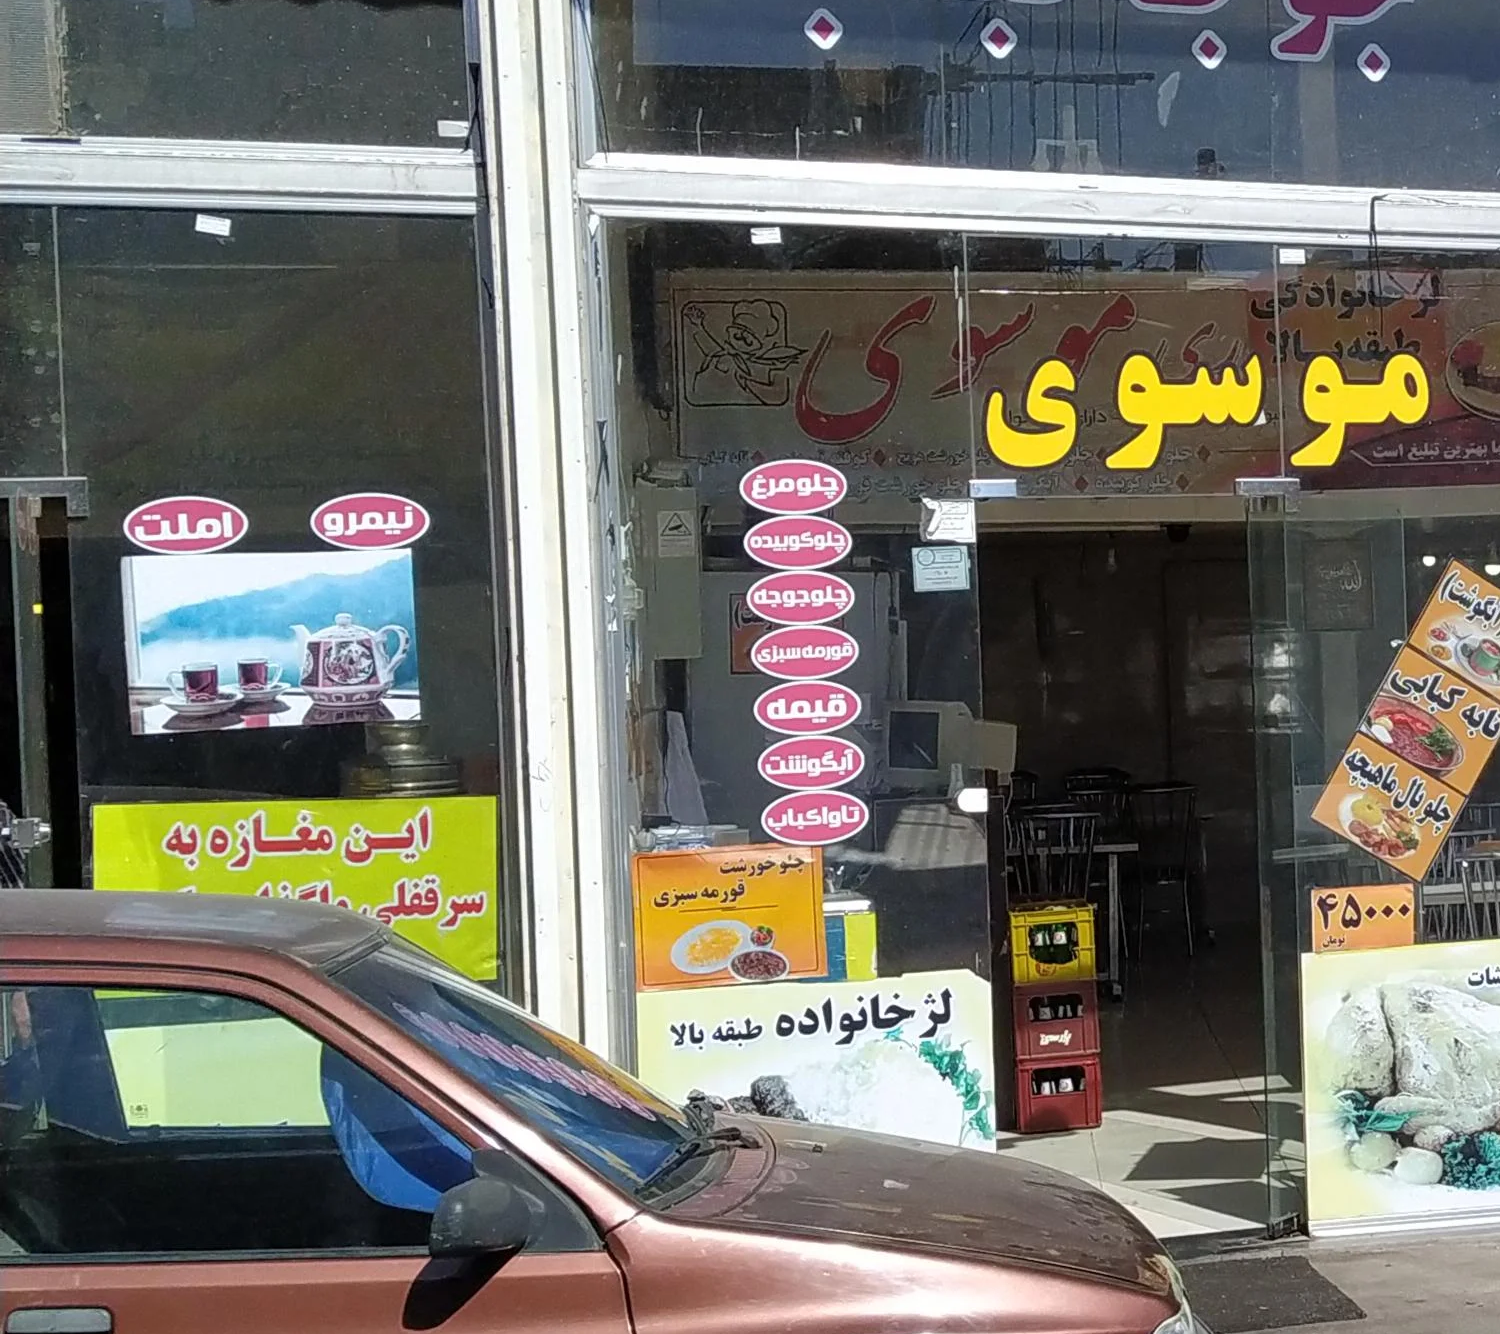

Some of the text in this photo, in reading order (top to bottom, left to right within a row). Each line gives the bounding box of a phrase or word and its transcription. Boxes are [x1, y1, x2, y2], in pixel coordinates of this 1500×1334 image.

[983, 351, 1432, 469] موسوی
[134, 508, 235, 546] املت
[322, 504, 417, 540] نیمرو
[765, 693, 848, 723] قیمه
[1389, 670, 1467, 712] کبابی
[764, 748, 855, 777] آبگوشت
[1344, 749, 1398, 794] ماهیچه
[1415, 795, 1451, 835] چلو
[163, 807, 433, 872] این مغازه به
[1322, 933, 1346, 948] تومان
[669, 1020, 705, 1052] بالا
[711, 1016, 764, 1049] طبقه
[774, 990, 917, 1047] خانواده
